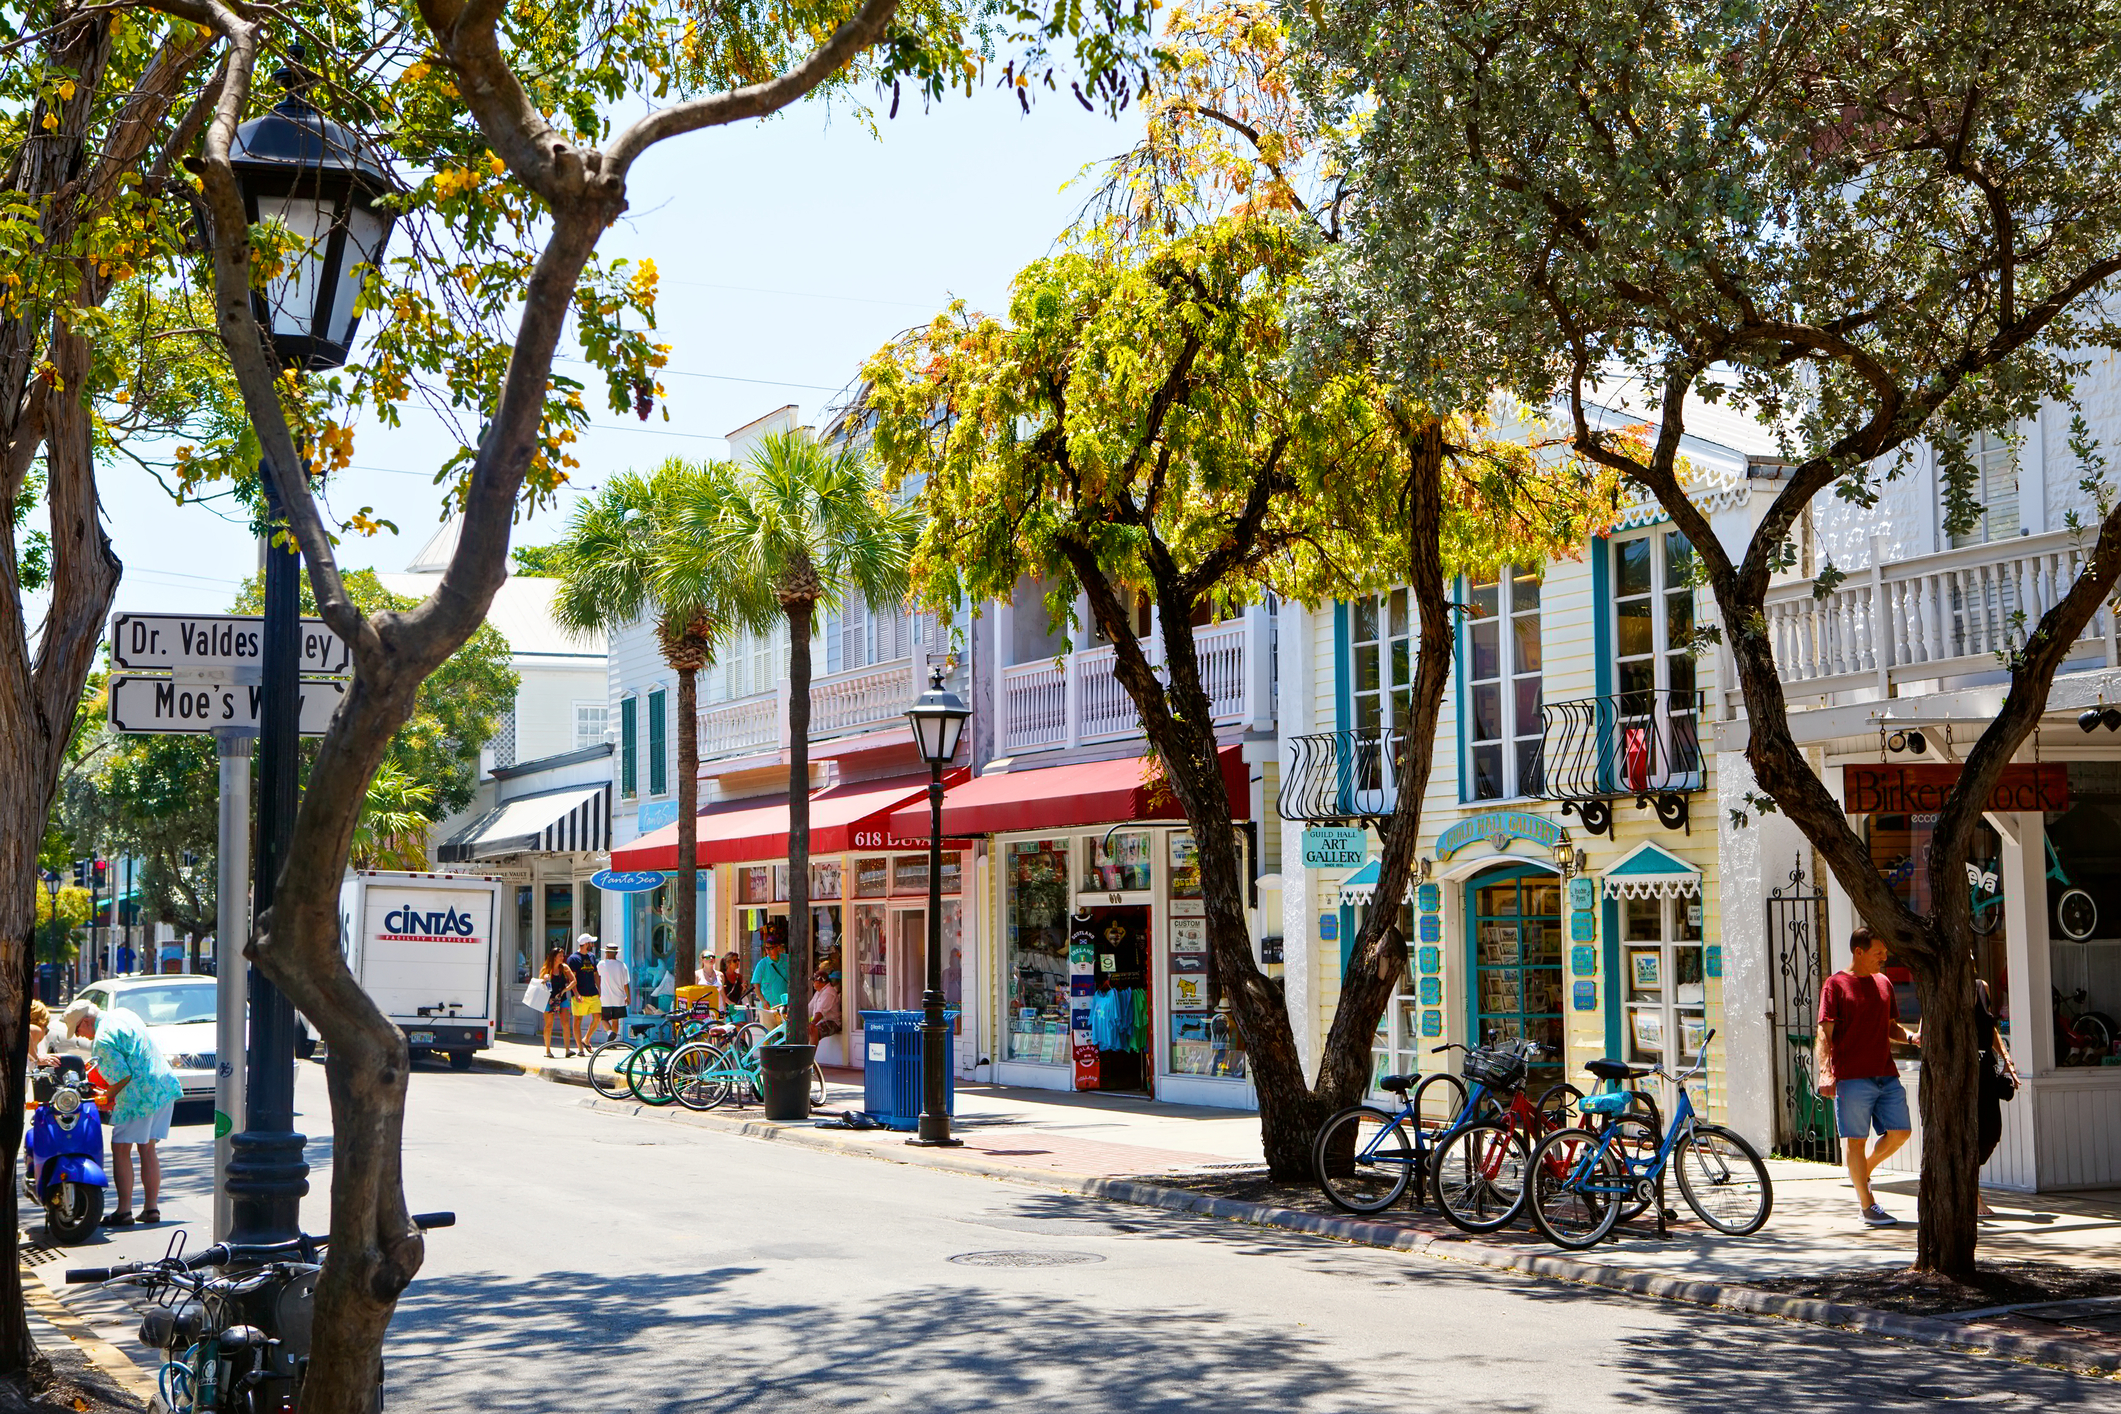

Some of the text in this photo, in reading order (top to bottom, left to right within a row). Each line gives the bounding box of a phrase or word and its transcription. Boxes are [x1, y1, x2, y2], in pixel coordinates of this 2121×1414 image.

[132, 621, 167, 655] Dr.
[180, 622, 259, 658] Valdes
[155, 682, 234, 720] Moe's
[1853, 769, 2064, 812] Birkeock.
[1911, 814, 1937, 823] ecco
[1446, 815, 1555, 848] GUILD HALL GALLERY
[855, 831, 882, 847] 618
[1321, 839, 1347, 850] ART
[1306, 850, 1363, 863] GALLERY
[599, 871, 657, 887] Fanta Sea
[1965, 861, 1999, 894] eva
[1072, 930, 1095, 940] SCOTLAND
[1070, 948, 1094, 957] IRELAND
[1103, 958, 1113, 968] 9
[1076, 1045, 1099, 1056] POLAND
